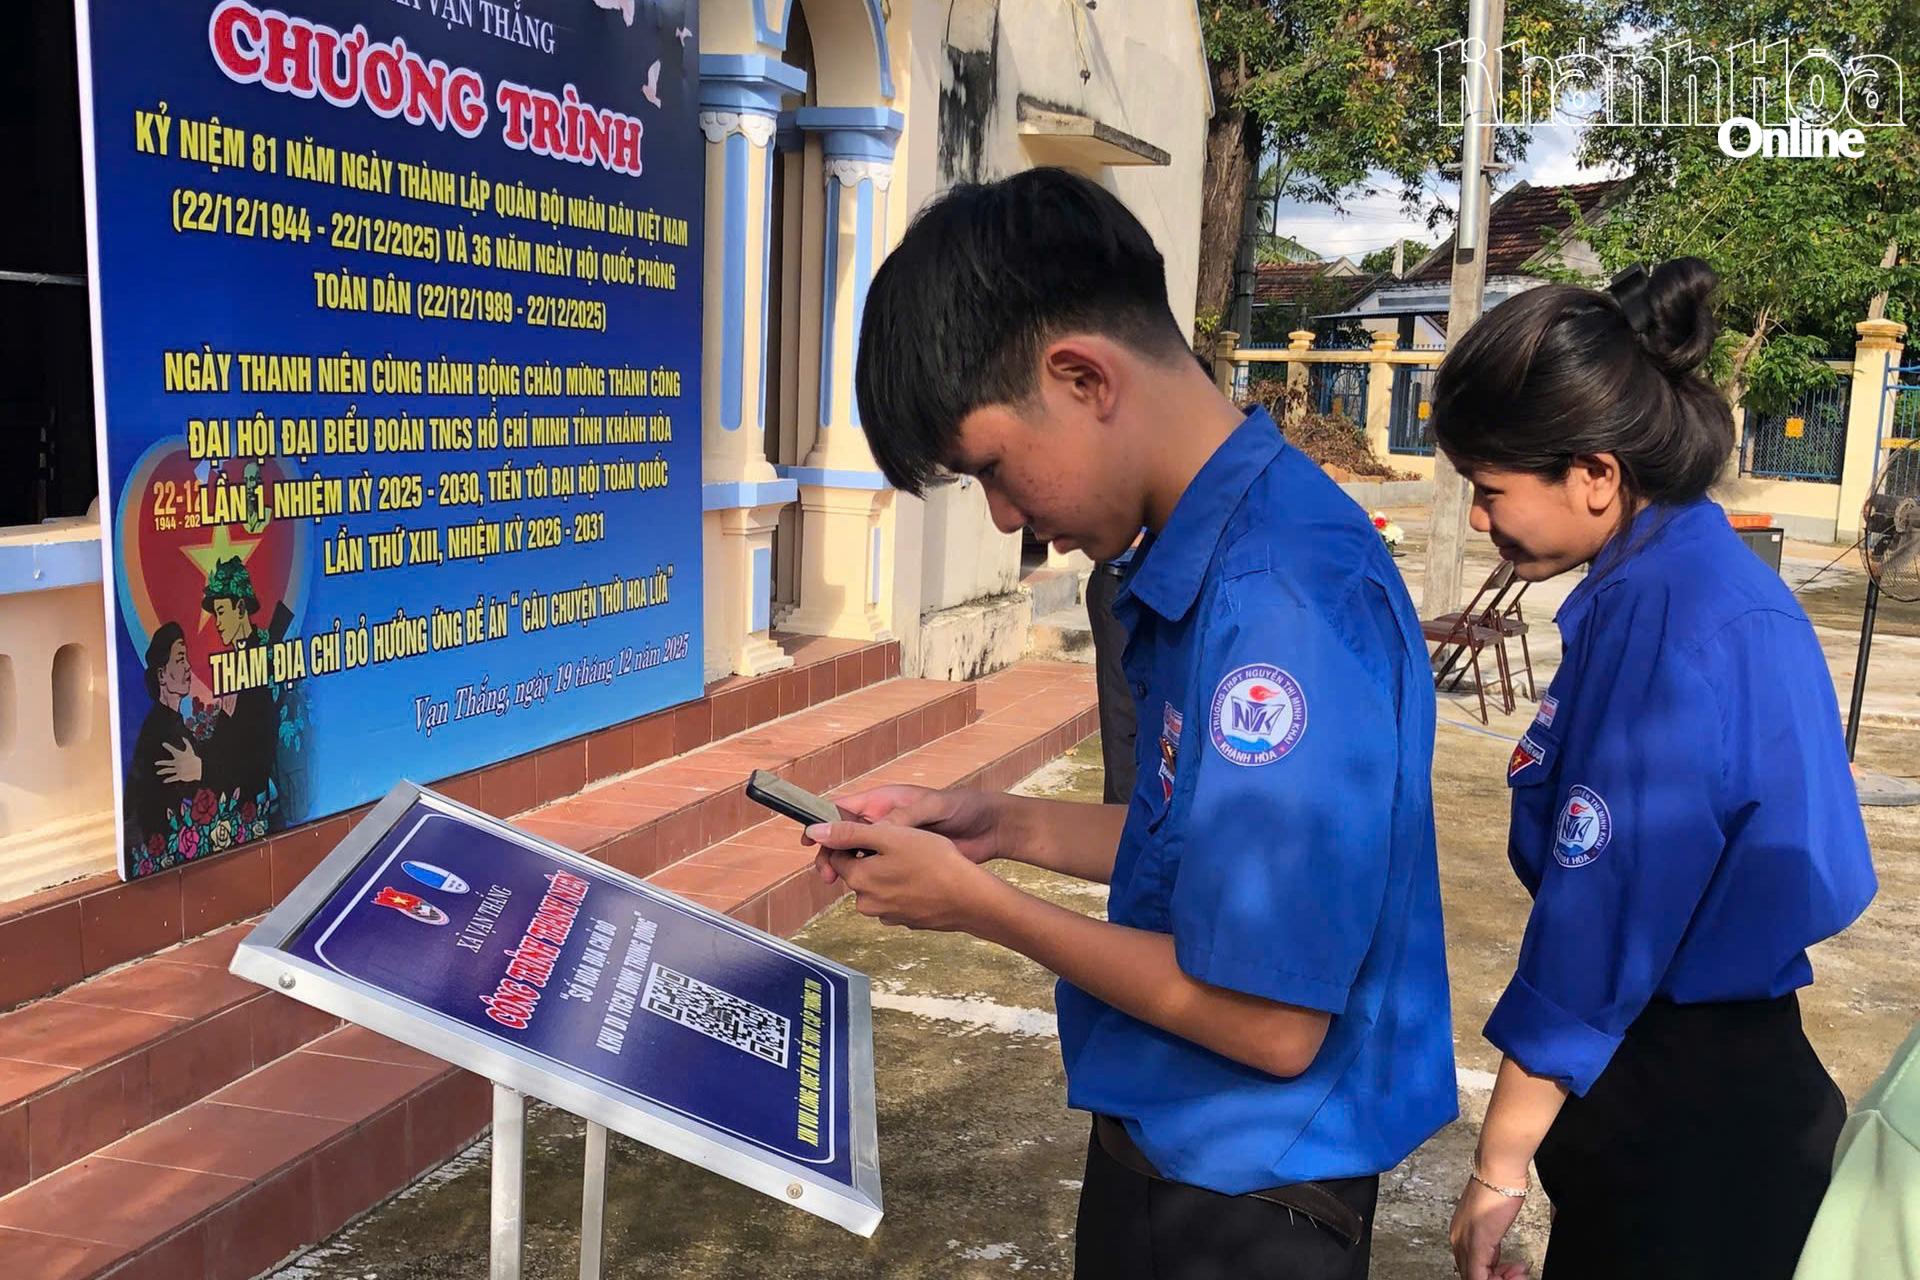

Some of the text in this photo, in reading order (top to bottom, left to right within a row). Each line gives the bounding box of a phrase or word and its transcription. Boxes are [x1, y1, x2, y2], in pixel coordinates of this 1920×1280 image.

[210, 2, 643, 177] CHƯƠNG TRÌNH
[135, 102, 688, 247] KỶ NIỆM 81 NĂM NGÀY THÀNH LẬP QUÂN ĐỘI NHÂN DÂN VIỆT NAM
[172, 188, 310, 243] (22/12/1944
[331, 212, 440, 263] 22/12/2025)
[446, 224, 468, 264] VÀ
[472, 234, 491, 267] 36
[496, 234, 531, 272] NĂM
[535, 239, 572, 276] NGÀY
[576, 245, 598, 285] HỘI
[602, 246, 635, 284] QUỐC
[638, 255, 676, 290] PHÒNG
[314, 268, 367, 311] TOÀN
[373, 273, 411, 314] DÂN
[417, 283, 512, 324] (22/12/1989
[527, 295, 606, 332] 22/12/2025)
[164, 345, 681, 402] NGÀY THANH NIÊN CÙNG HÀNH ĐỘNG CHÀO MỪNG THÀNH CÔNG
[188, 404, 672, 467] ĐẠI HỘI ĐẠI BIỂU ĐOÀN TNCS HỒ CHÍ MINH TỈNH KHÁNH HÒA
[201, 472, 247, 525] LẦN
[273, 472, 343, 524] NHIỆM
[348, 470, 373, 515] KỲ
[378, 476, 422, 510] 2025
[439, 472, 484, 506] 2030,
[488, 460, 522, 501] TIẾN
[525, 462, 548, 497] TỚI
[552, 466, 575, 502] ĐẠI
[578, 459, 600, 499] HỘI
[603, 457, 635, 491] TOÀN
[638, 450, 669, 491] QUỐC
[154, 516, 176, 531] 1944
[325, 526, 363, 575] LẦN
[369, 526, 405, 568] THỨ
[408, 530, 443, 564] XIII,
[448, 518, 500, 563] NHIỆM
[505, 515, 524, 551] KỲ
[527, 518, 562, 549] 2026
[574, 513, 605, 542] 2031
[209, 641, 269, 696] THĂM
[273, 639, 306, 689] ĐỊA
[310, 619, 341, 675] CHỈ
[345, 613, 368, 668] ĐỎ
[373, 609, 427, 663] HƯỞNG
[431, 607, 463, 650] ỨNG
[466, 593, 484, 643] ĐỀ
[488, 596, 508, 640] ÁN
[551, 582, 597, 628] CHUYỆN
[600, 574, 623, 615] THỜI
[626, 576, 647, 609] HOA
[415, 632, 690, 737] Vạn Thắng, ngày 19 tháng 12 năm 2025
[1223, 673, 1243, 693] THPT
[1292, 697, 1303, 721] MINH
[1284, 723, 1301, 746] KHAI
[526, 892, 580, 946] THANH
[503, 934, 561, 988] TRÌNH
[623, 938, 652, 972] TRUNG
[478, 977, 541, 1030] CÔNG
[603, 1013, 629, 1032] DI
[604, 989, 636, 1018] TÍCH
[595, 1025, 625, 1055] KHU
